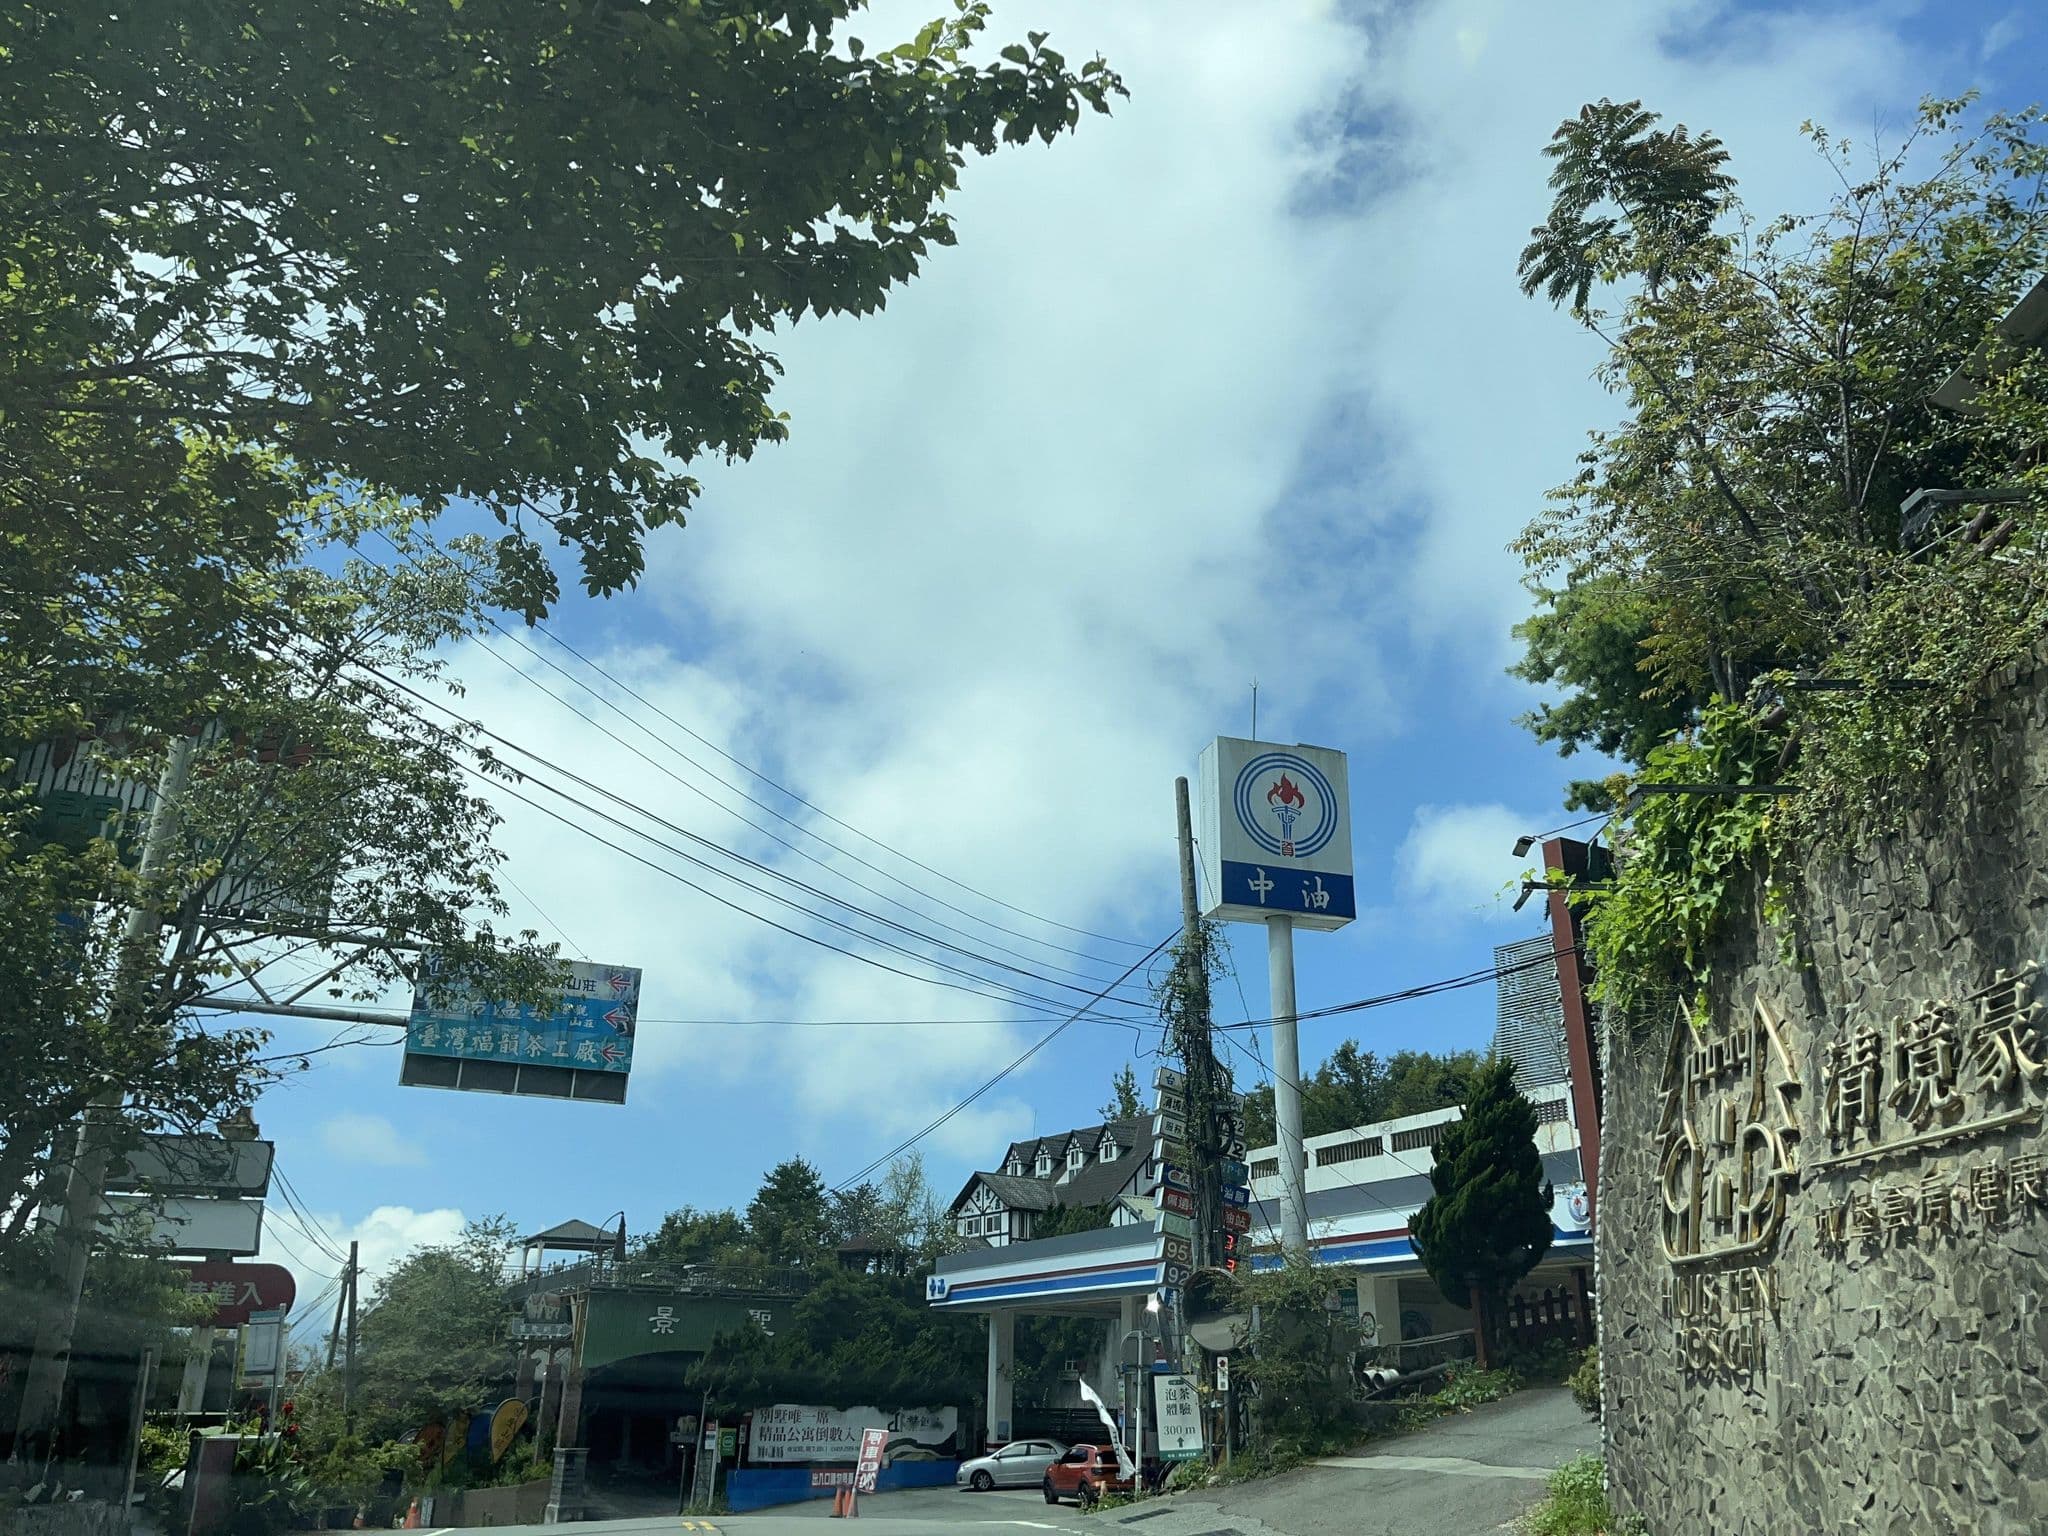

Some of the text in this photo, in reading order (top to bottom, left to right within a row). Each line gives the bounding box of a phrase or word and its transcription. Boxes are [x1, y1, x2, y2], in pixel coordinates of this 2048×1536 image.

[1248, 867, 1330, 909] 中油
[1822, 961, 2044, 1137] 清境豪
[1167, 1242, 1188, 1261] 95
[1168, 1267, 1189, 1286] 92
[1660, 1273, 1719, 1319] HUIS
[1165, 1387, 1191, 1402] 泡茶
[1163, 1425, 1196, 1435] 300 m
